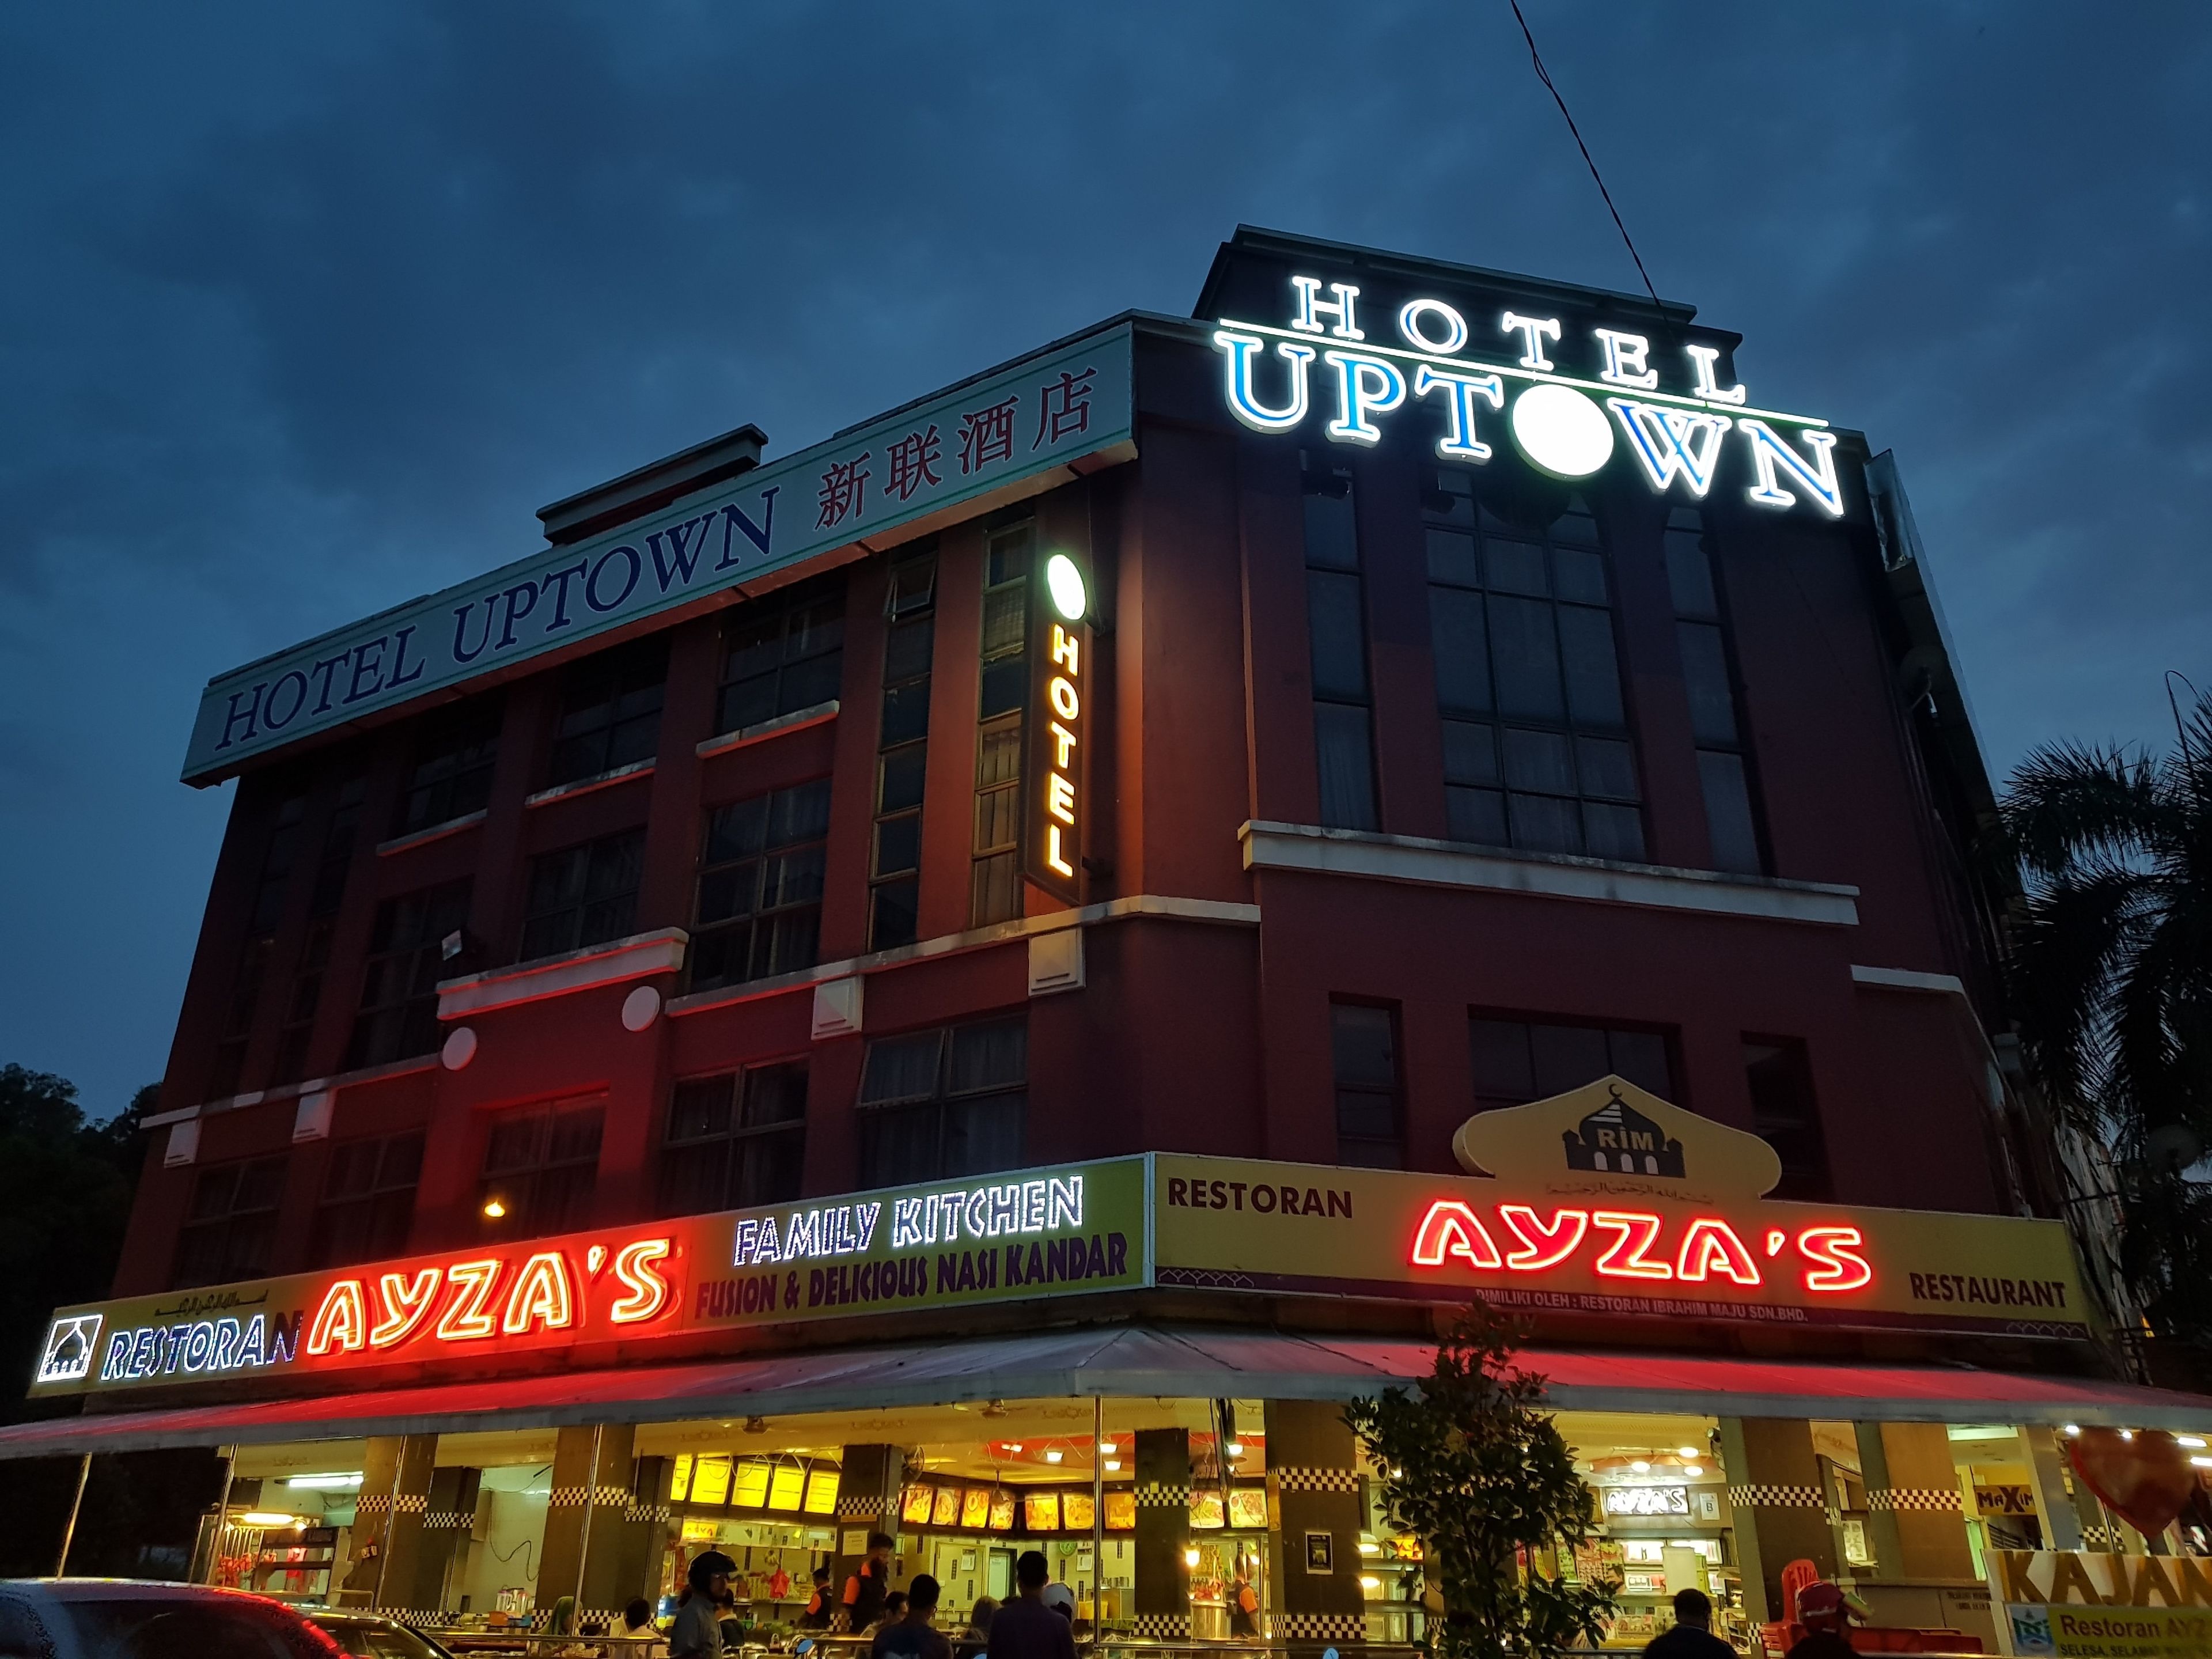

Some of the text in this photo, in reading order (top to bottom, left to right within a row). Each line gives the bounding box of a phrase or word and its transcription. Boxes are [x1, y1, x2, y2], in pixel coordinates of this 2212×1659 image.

[1290, 274, 1747, 406] HOTEL
[813, 366, 1099, 531] 新联酒店
[1213, 329, 1847, 518] UPTOWN
[214, 484, 781, 752] HOTEL UPTOWN
[1048, 622, 1081, 878] HOTEL
[733, 1174, 1086, 1267] FAMILY KITCHEN
[1168, 1177, 1353, 1219] RESTORAN
[695, 1232, 1128, 1320] FUSION & DELICIOUS NASI KANDAR
[1411, 1199, 1873, 1293] AYZA'S
[1910, 1272, 2067, 1309] RESTAURANT
[306, 1238, 674, 1355] AYZA'S
[1476, 1289, 1531, 1305] DIMILIKI
[1535, 1293, 1570, 1308] OLEH
[1580, 1295, 1650, 1312] RESTORAN
[1653, 1300, 1707, 1315] IBRAHIM
[1710, 1303, 1747, 1317] MAJU
[100, 1309, 304, 1381] RESTORAN
[2059, 1614, 2161, 1638] Restoran
